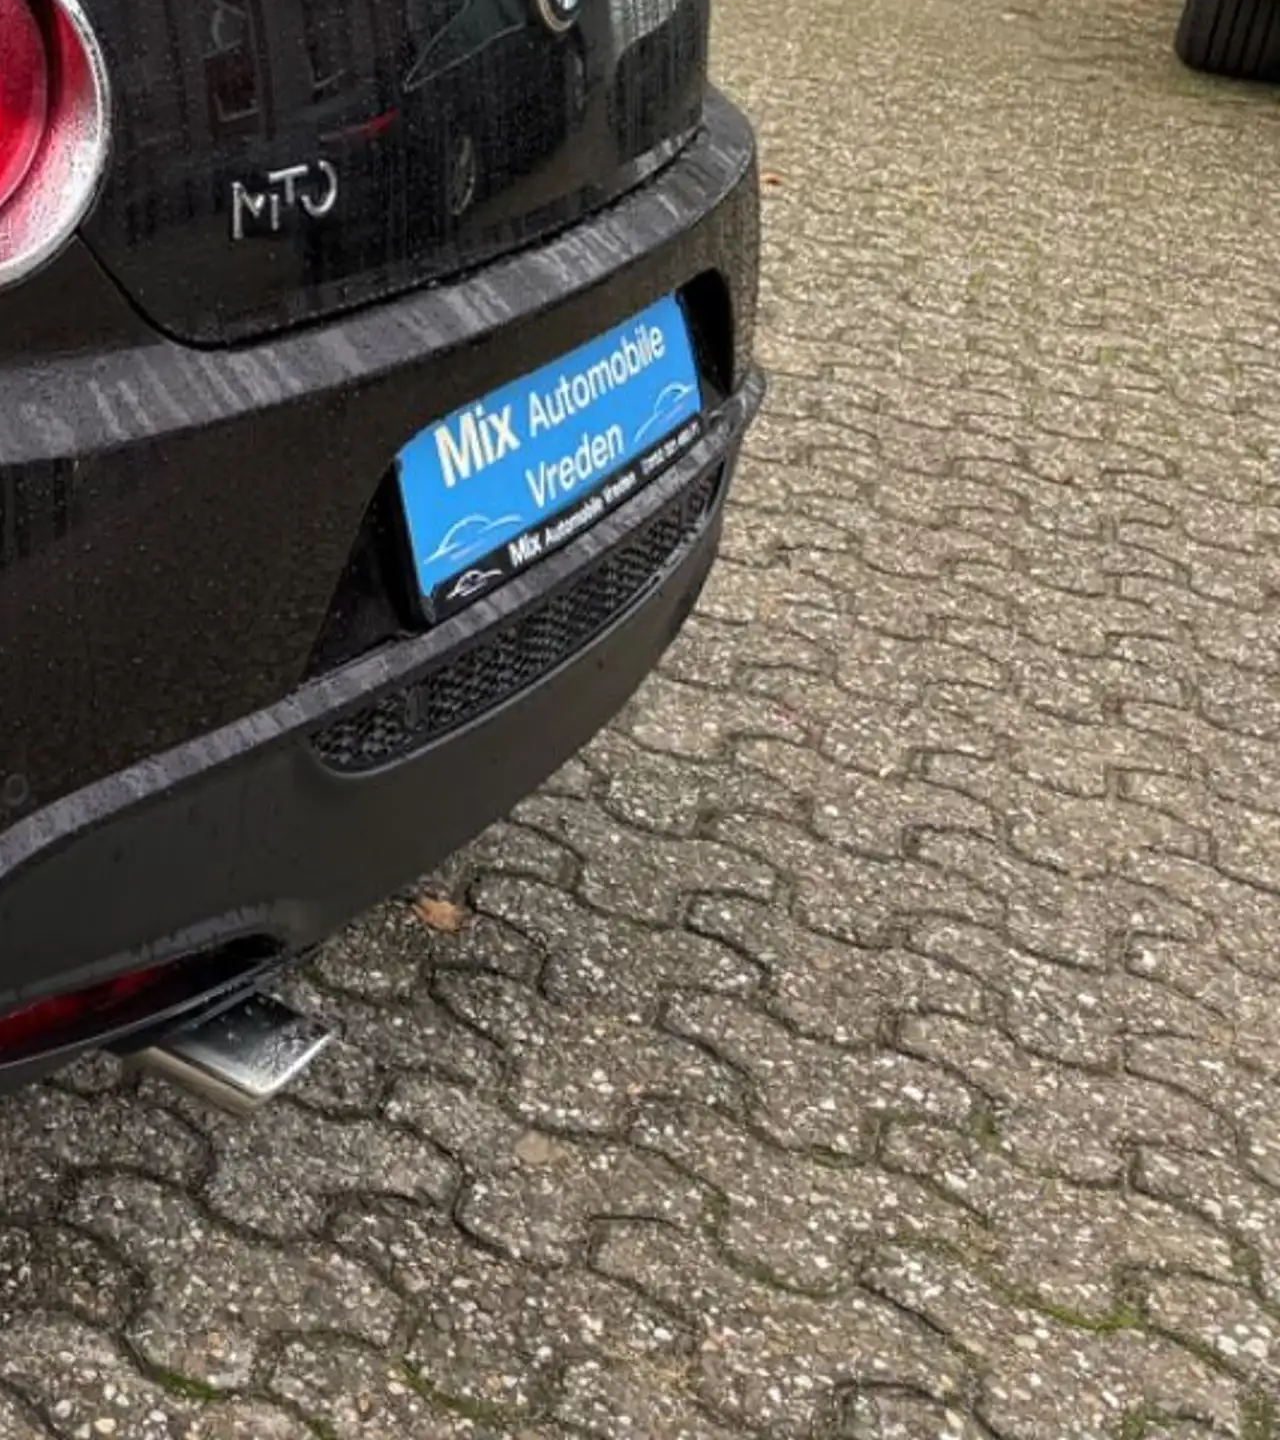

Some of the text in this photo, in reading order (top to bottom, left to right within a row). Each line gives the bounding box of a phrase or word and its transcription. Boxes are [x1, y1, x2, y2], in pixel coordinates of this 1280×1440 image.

[434, 324, 665, 488] Mix Automobile
[525, 423, 624, 508] Vreden
[508, 533, 541, 567] Mix
